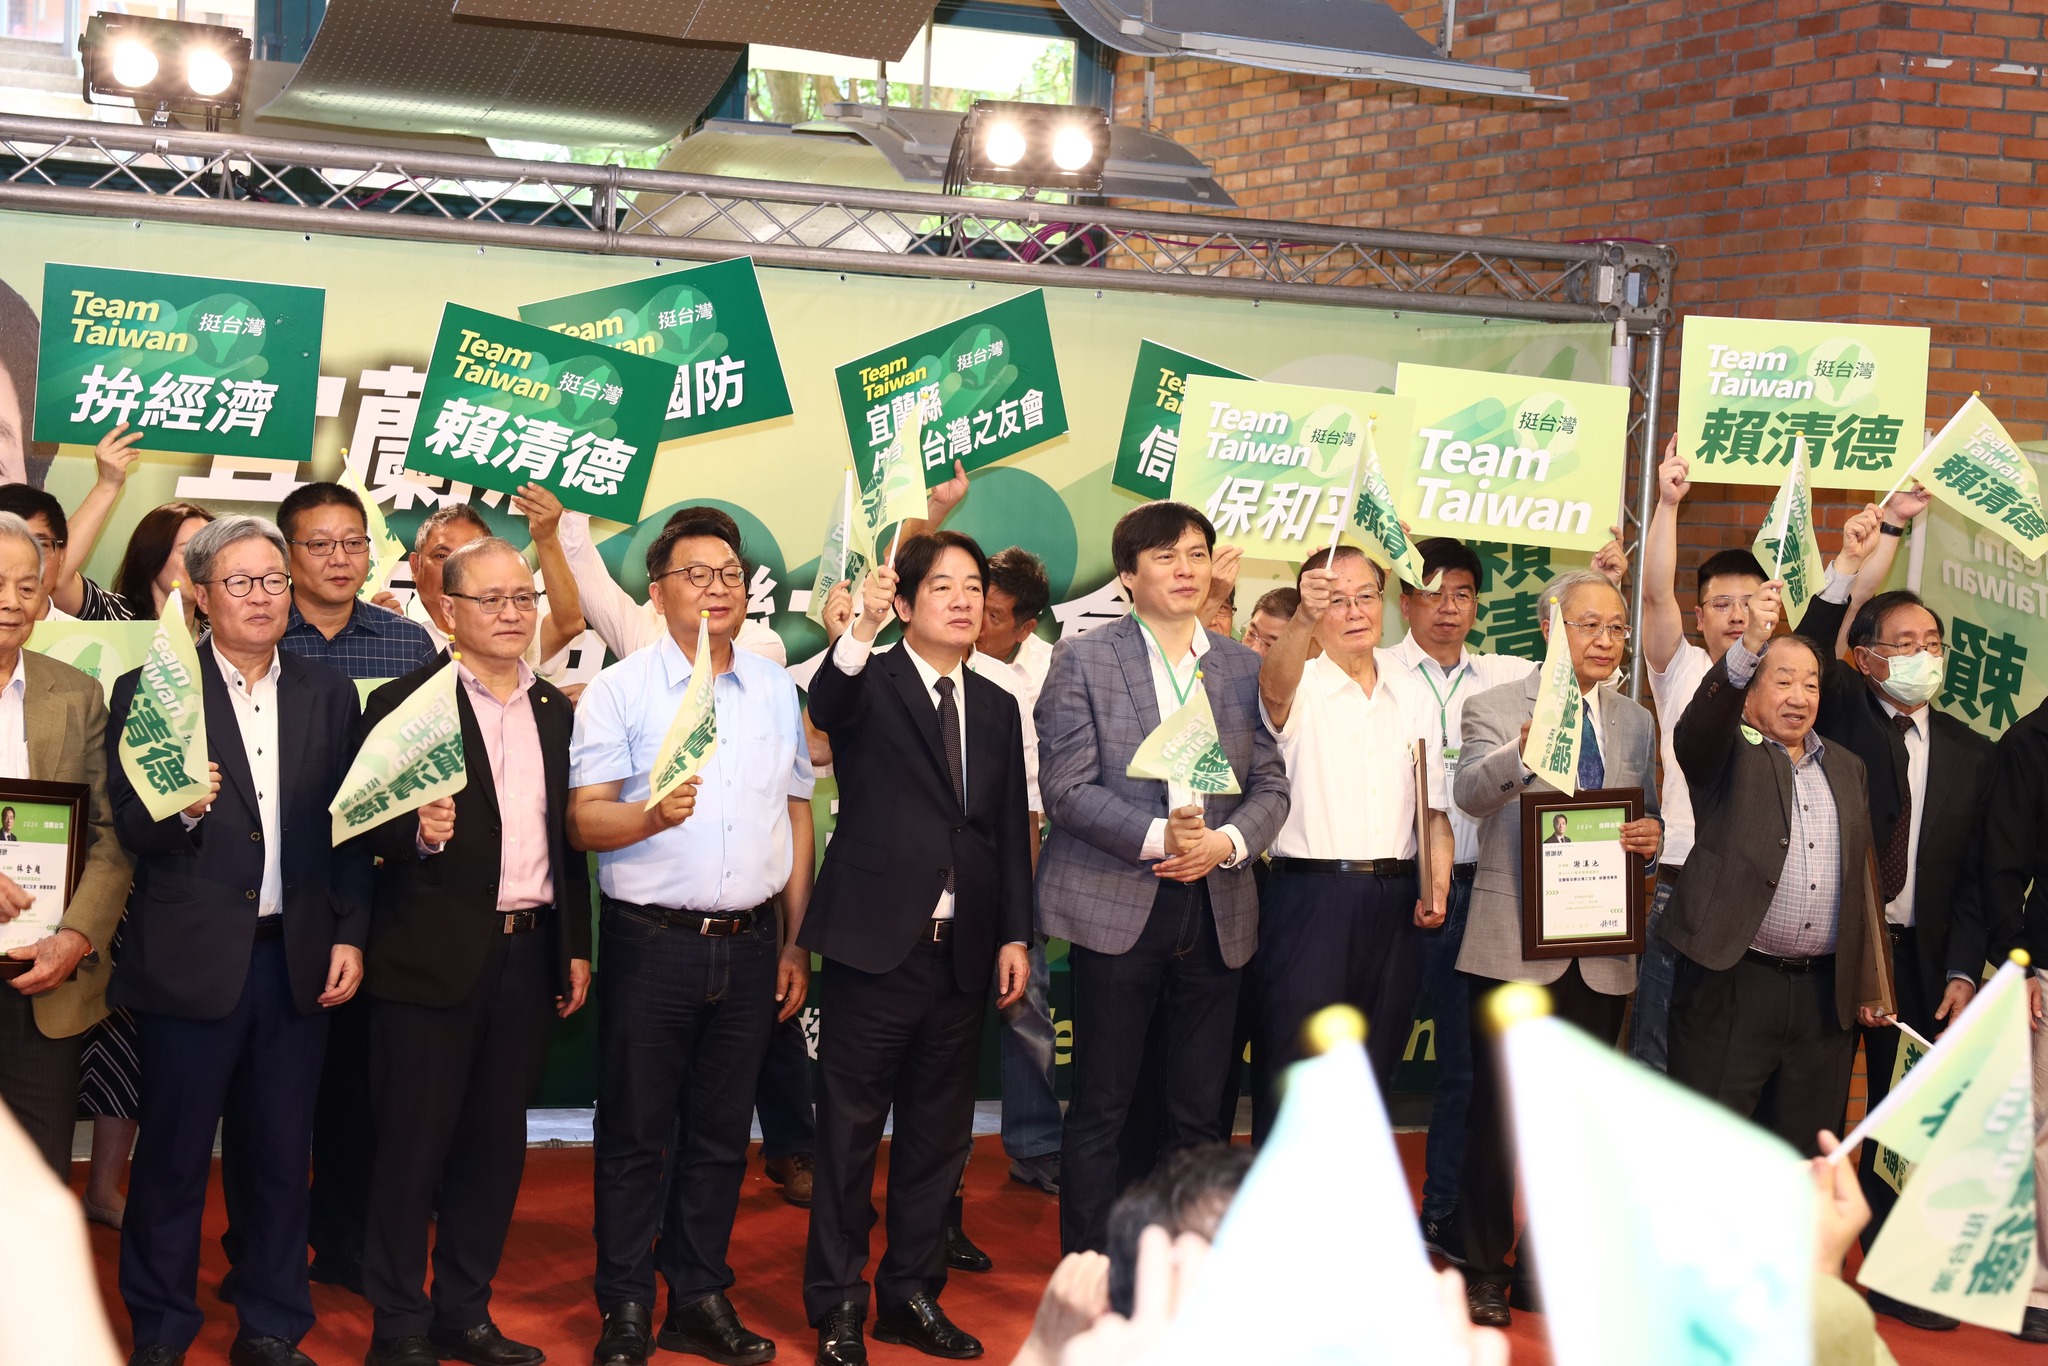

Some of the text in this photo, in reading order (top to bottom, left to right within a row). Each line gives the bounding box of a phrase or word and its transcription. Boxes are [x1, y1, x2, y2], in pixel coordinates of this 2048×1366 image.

[71, 290, 160, 322] Team
[197, 313, 266, 337] 挺台灣
[658, 301, 714, 330] 挺台灣
[71, 318, 188, 352] Taiwan
[458, 329, 533, 369] Team
[859, 356, 907, 386] Team
[957, 340, 1004, 372] 挺台灣
[1708, 344, 1788, 372] Team
[1814, 360, 1875, 380] 挺台灣
[452, 355, 551, 402] Taiwan
[557, 371, 623, 405] 挺台灣
[863, 366, 927, 402] Taiwan
[1708, 371, 1815, 399] Taiwan
[1209, 401, 1289, 435] Team
[1519, 411, 1577, 435] 挺台灣
[425, 397, 638, 495] 賴清德
[1136, 424, 1179, 483] 信
[1206, 432, 1312, 467] Taiwan
[1310, 428, 1357, 447] 挺台灣
[1418, 428, 1551, 482] Team
[1696, 408, 1904, 471] 賴清德
[1974, 421, 2020, 462] Team
[1963, 435, 2025, 485] Taiwan
[1417, 476, 1593, 535] Taiwan
[1933, 452, 2047, 541] 賴清德
[1353, 492, 1410, 566] 賴清
[1766, 524, 1805, 608] 清德
[153, 624, 191, 687] Team
[144, 655, 185, 719] iwan
[125, 697, 199, 796] 清德
